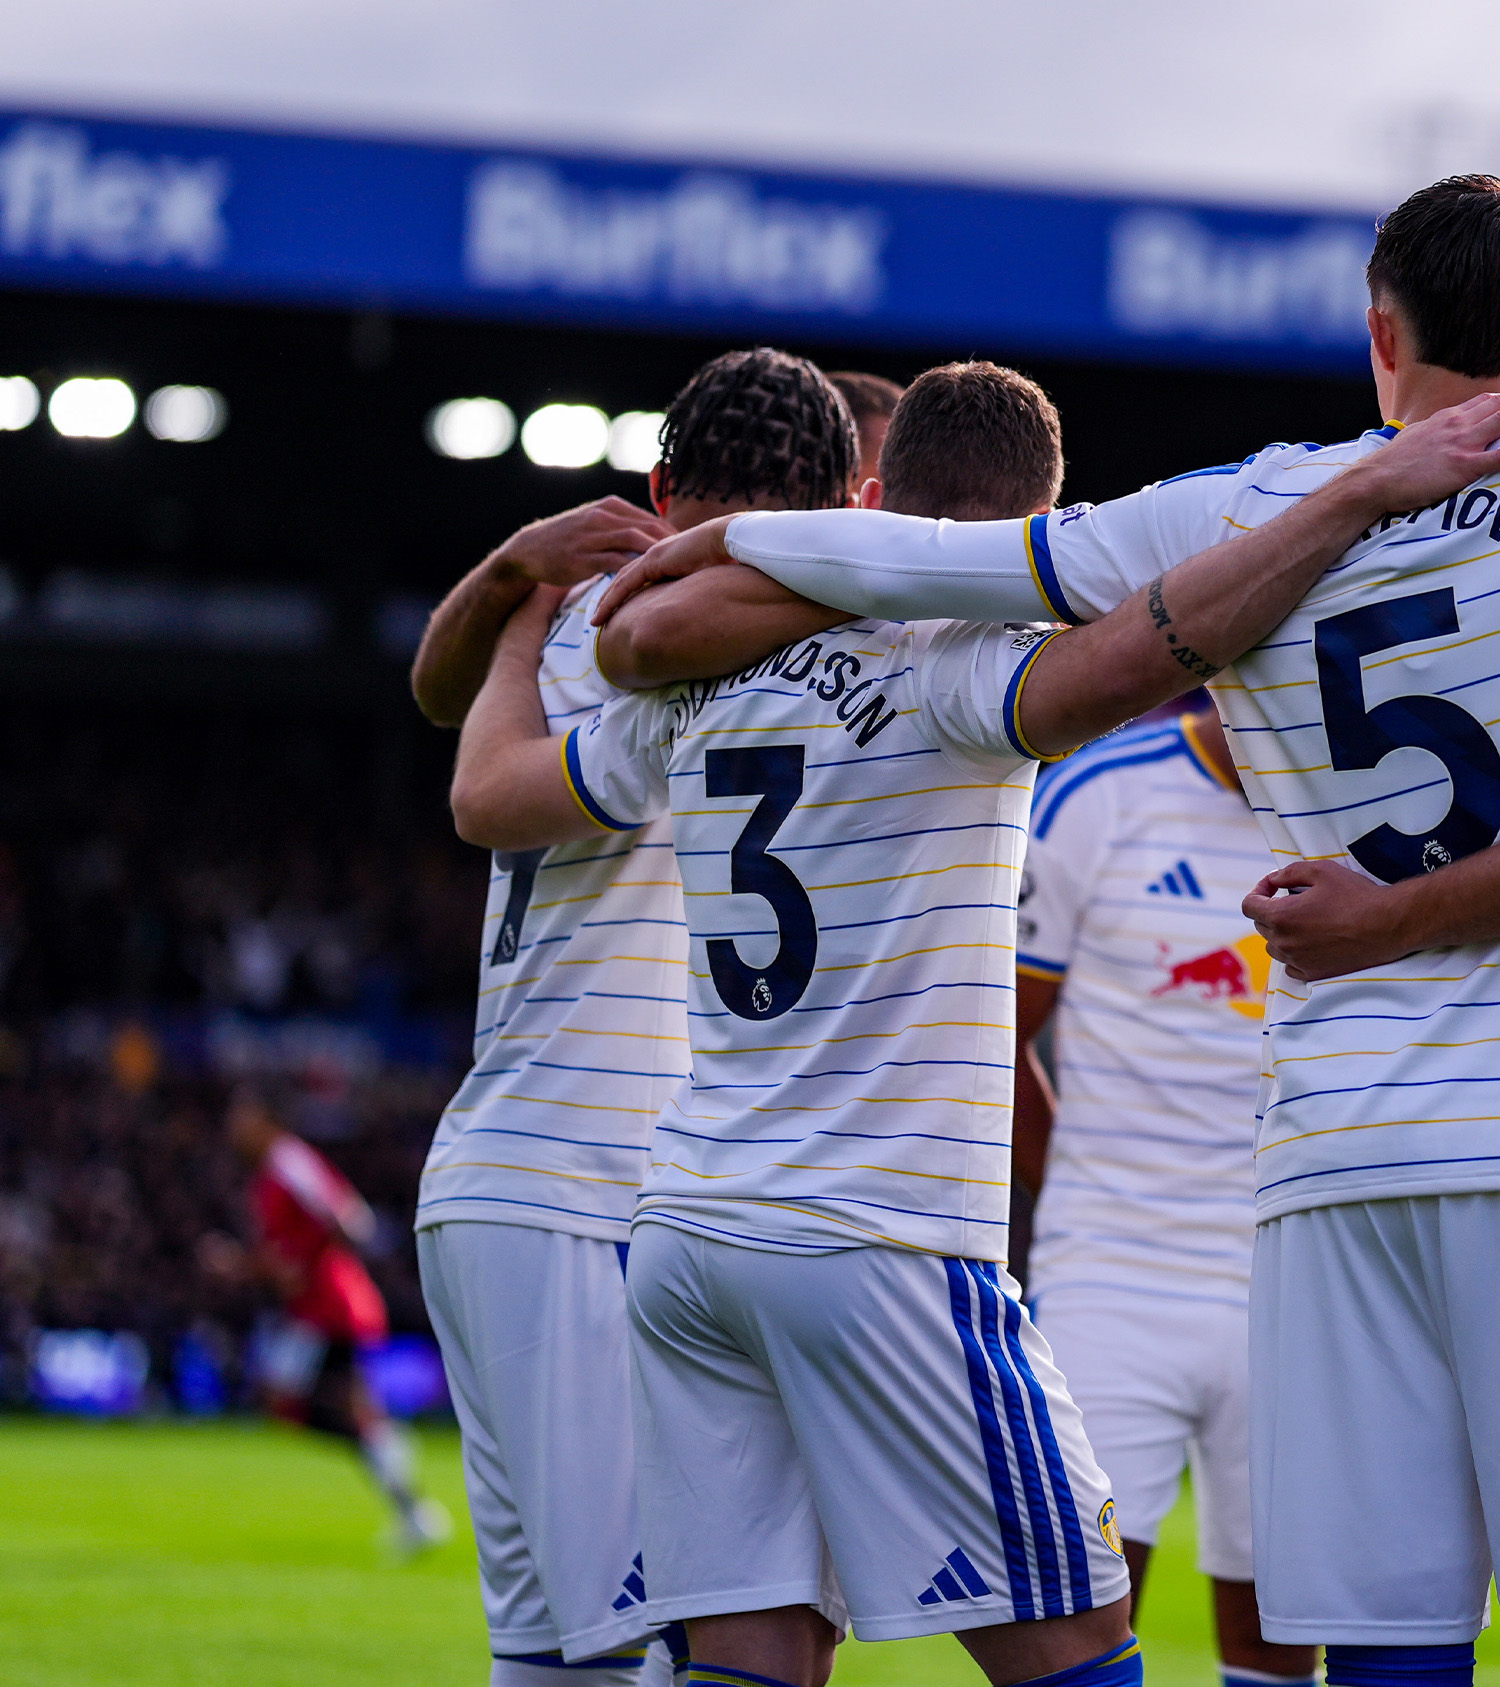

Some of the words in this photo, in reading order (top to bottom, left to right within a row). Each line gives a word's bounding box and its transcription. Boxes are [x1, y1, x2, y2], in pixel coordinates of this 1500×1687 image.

[0, 118, 228, 268] flex
[464, 158, 886, 308] Burflex
[1108, 205, 1368, 338] Burf
[704, 743, 818, 1021] 3
